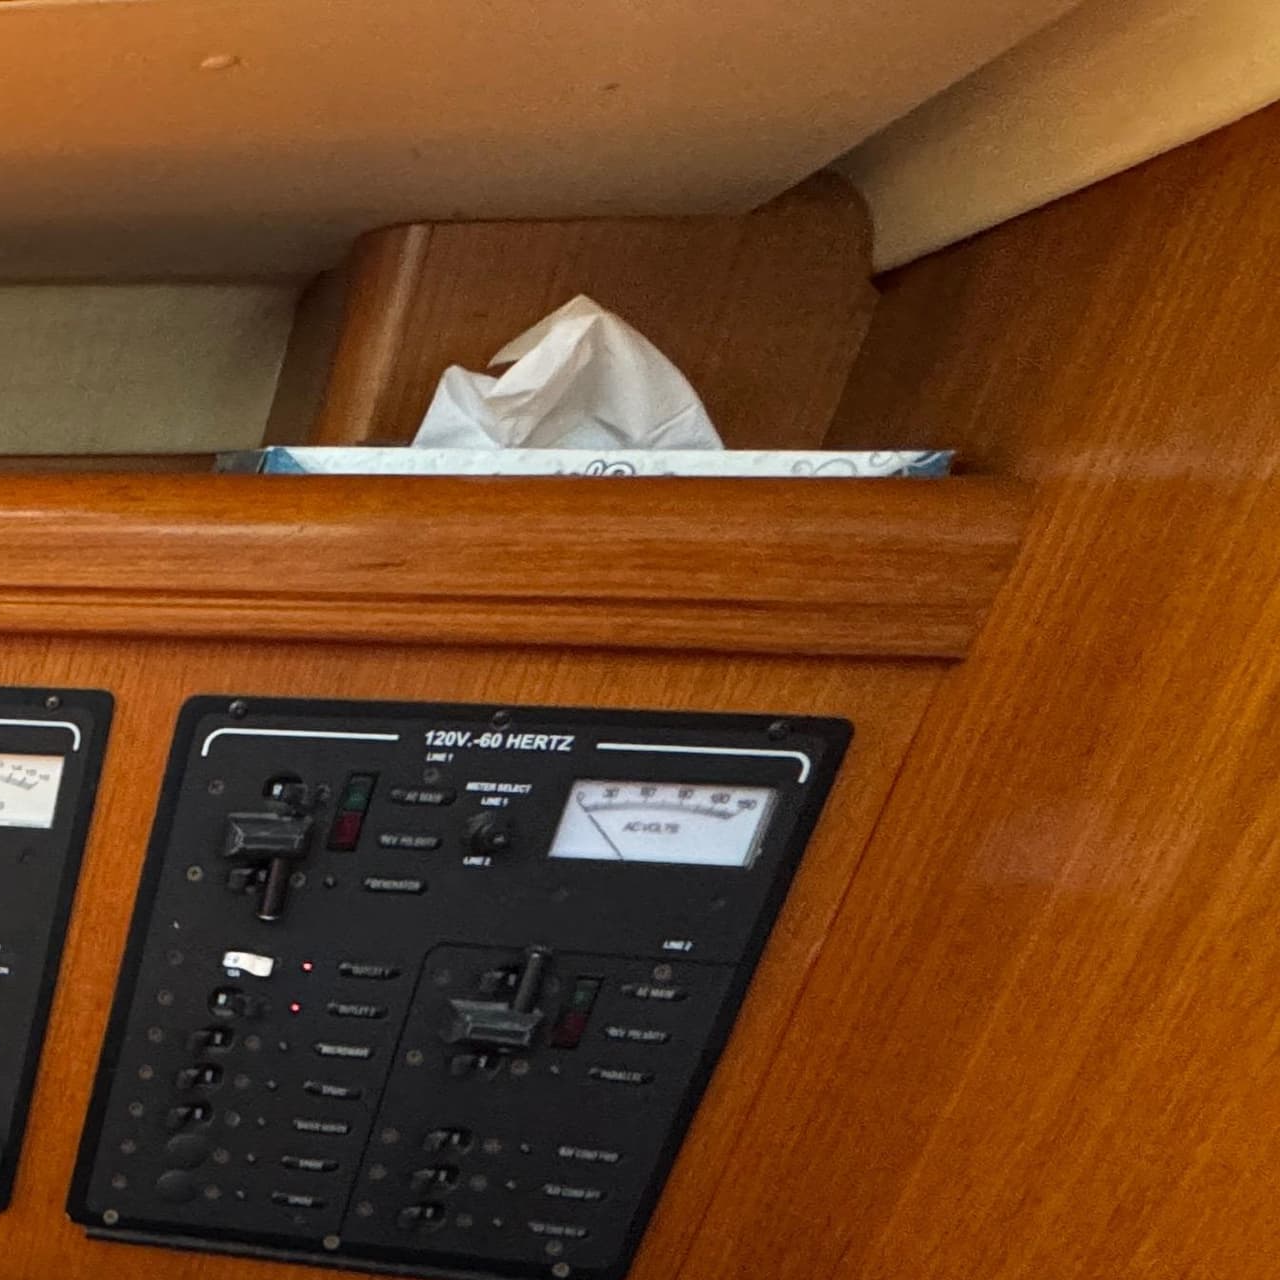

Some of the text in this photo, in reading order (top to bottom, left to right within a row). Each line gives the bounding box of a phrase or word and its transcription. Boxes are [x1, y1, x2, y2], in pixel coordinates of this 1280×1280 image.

[506, 732, 575, 751] HERTZ
[426, 752, 446, 763] LINE
[497, 782, 532, 795] SELECT
[481, 796, 500, 807] LINE
[623, 821, 642, 832] AC
